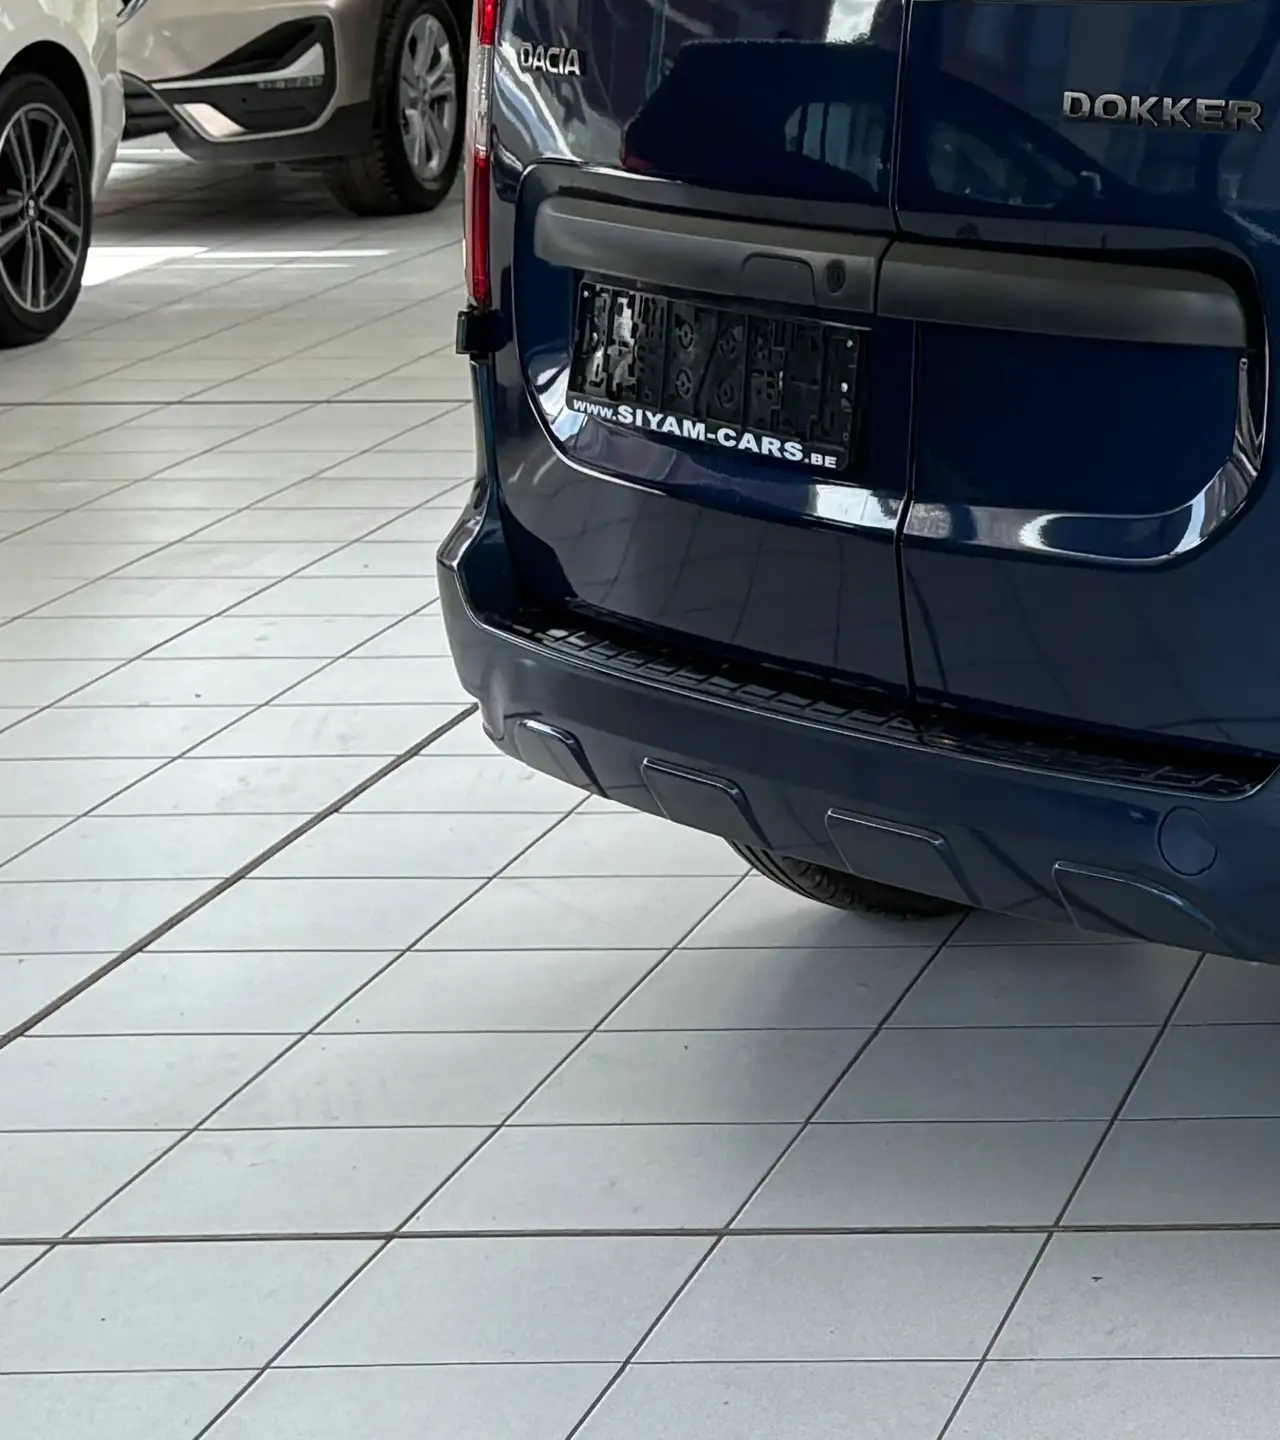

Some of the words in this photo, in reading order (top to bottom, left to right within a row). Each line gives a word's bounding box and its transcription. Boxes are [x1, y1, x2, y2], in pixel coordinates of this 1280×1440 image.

[520, 42, 581, 76] DACIA
[1062, 91, 1263, 132] DOKKER
[573, 398, 838, 469] www.SIYAM-CARS.BE
